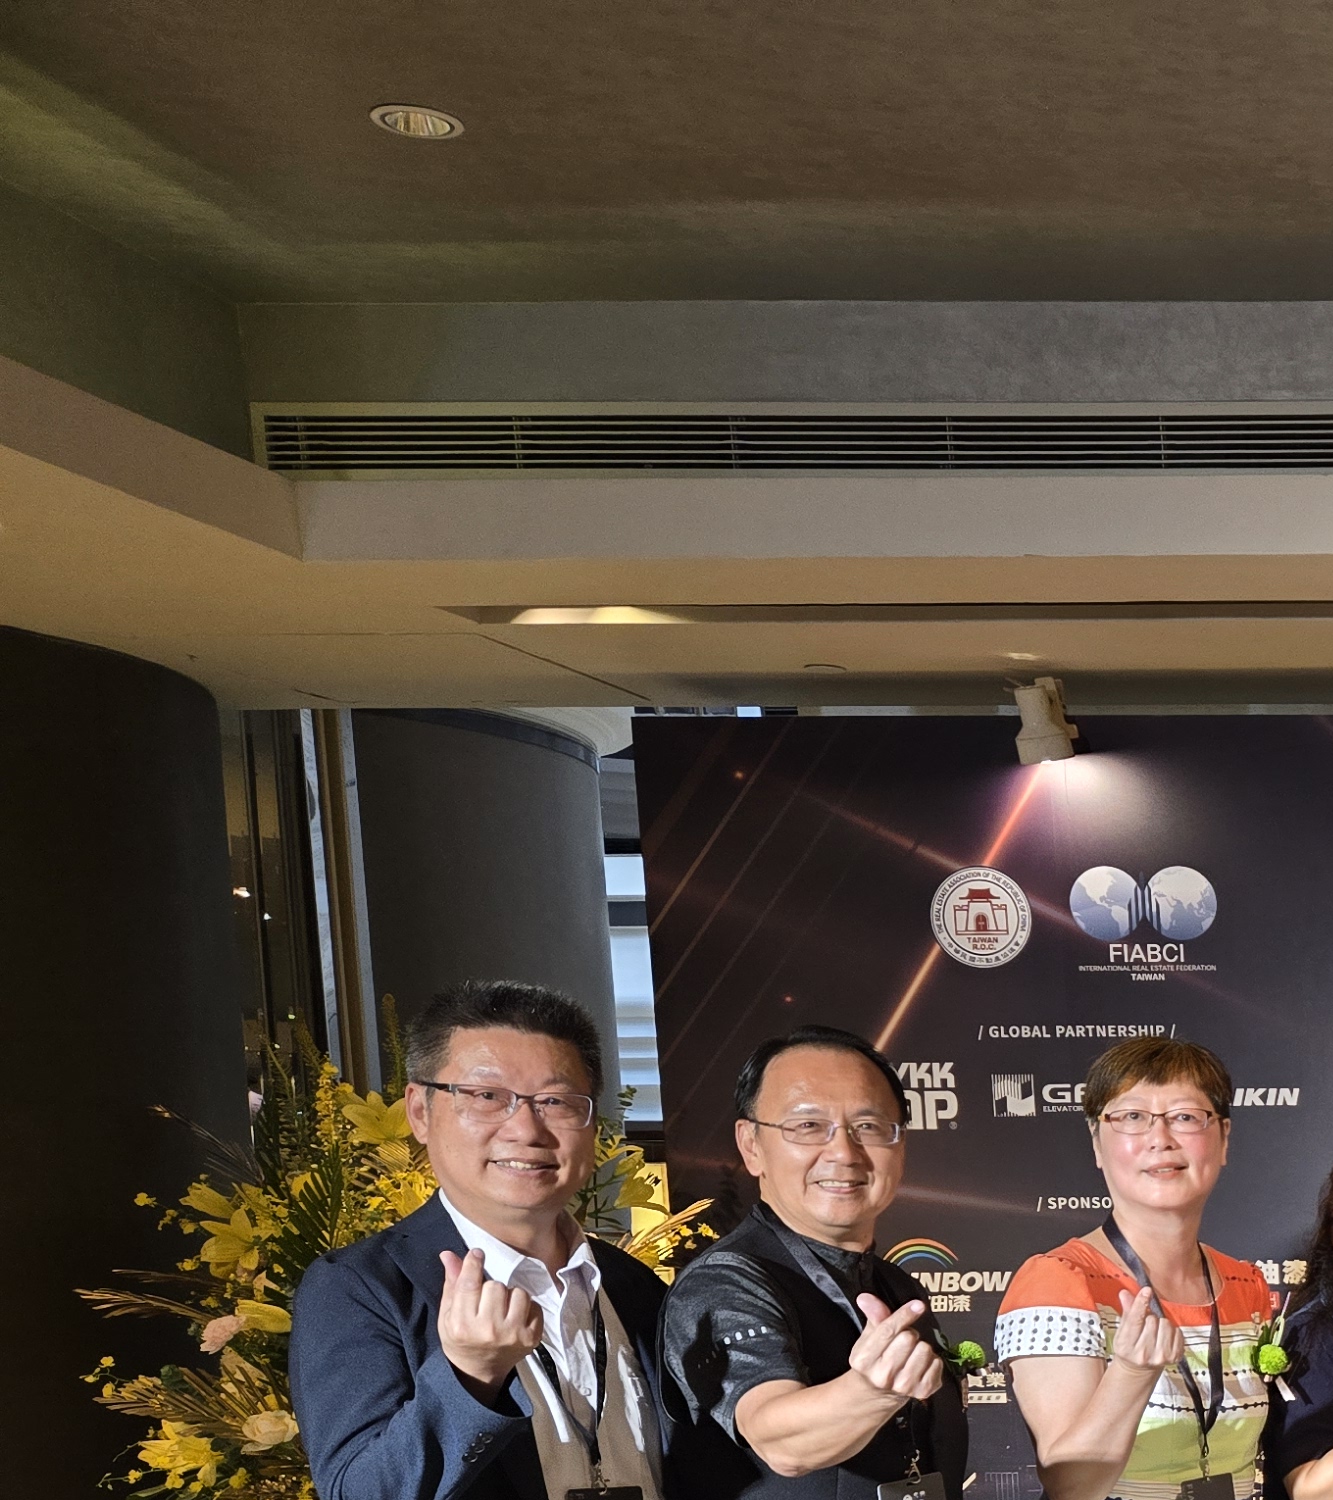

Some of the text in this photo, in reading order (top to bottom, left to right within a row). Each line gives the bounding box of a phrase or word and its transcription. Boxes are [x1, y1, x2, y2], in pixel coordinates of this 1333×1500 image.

[948, 872, 981, 889] ASSOCIATION
[1109, 943, 1185, 963] FIABCI
[1175, 964, 1217, 972] FEDERATION
[1130, 973, 1166, 981] TAIWAN
[989, 1025, 1050, 1038] GLOBAL
[1055, 1024, 1165, 1038] PARTNERSHIP
[1230, 1088, 1299, 1106] IKIN
[1047, 1196, 1113, 1209] SPONSO
[1254, 1259, 1307, 1285] 油漆
